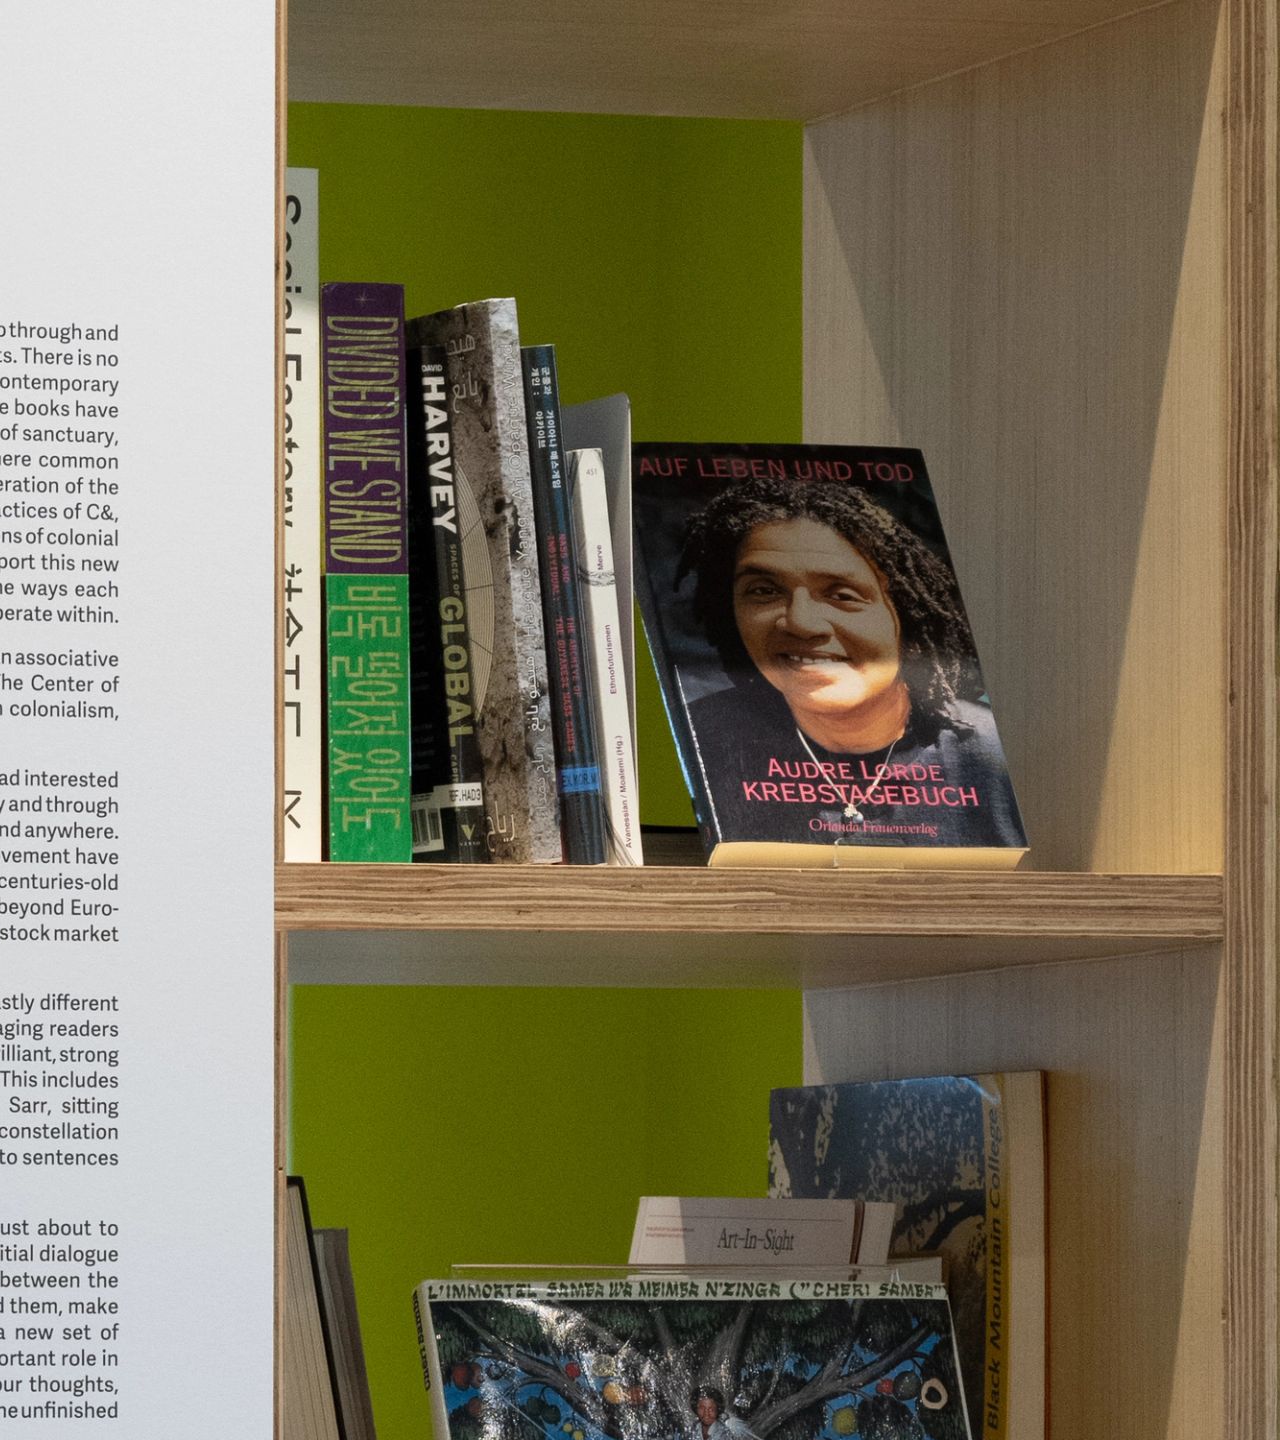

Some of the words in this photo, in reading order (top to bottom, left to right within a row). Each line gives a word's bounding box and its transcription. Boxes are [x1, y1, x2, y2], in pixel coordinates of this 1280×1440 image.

[327, 316, 399, 419] DIVIDED
[15, 398, 69, 416] books
[76, 400, 118, 417] have
[329, 429, 399, 470] WE
[420, 371, 456, 538] HARVEY
[640, 458, 689, 478] AUF
[697, 459, 789, 481] LEBEN
[795, 462, 853, 483] UND
[858, 462, 915, 483] TOD
[330, 480, 401, 562] STAND
[743, 781, 977, 805] KREBSTAGEBUCH
[768, 758, 853, 782] AUDRE
[860, 759, 944, 784] LORDE
[988, 1107, 1006, 1205] College
[717, 1228, 794, 1252] Art-In-Sight
[987, 1221, 1003, 1350] Mountain
[987, 1359, 1001, 1432] Black
